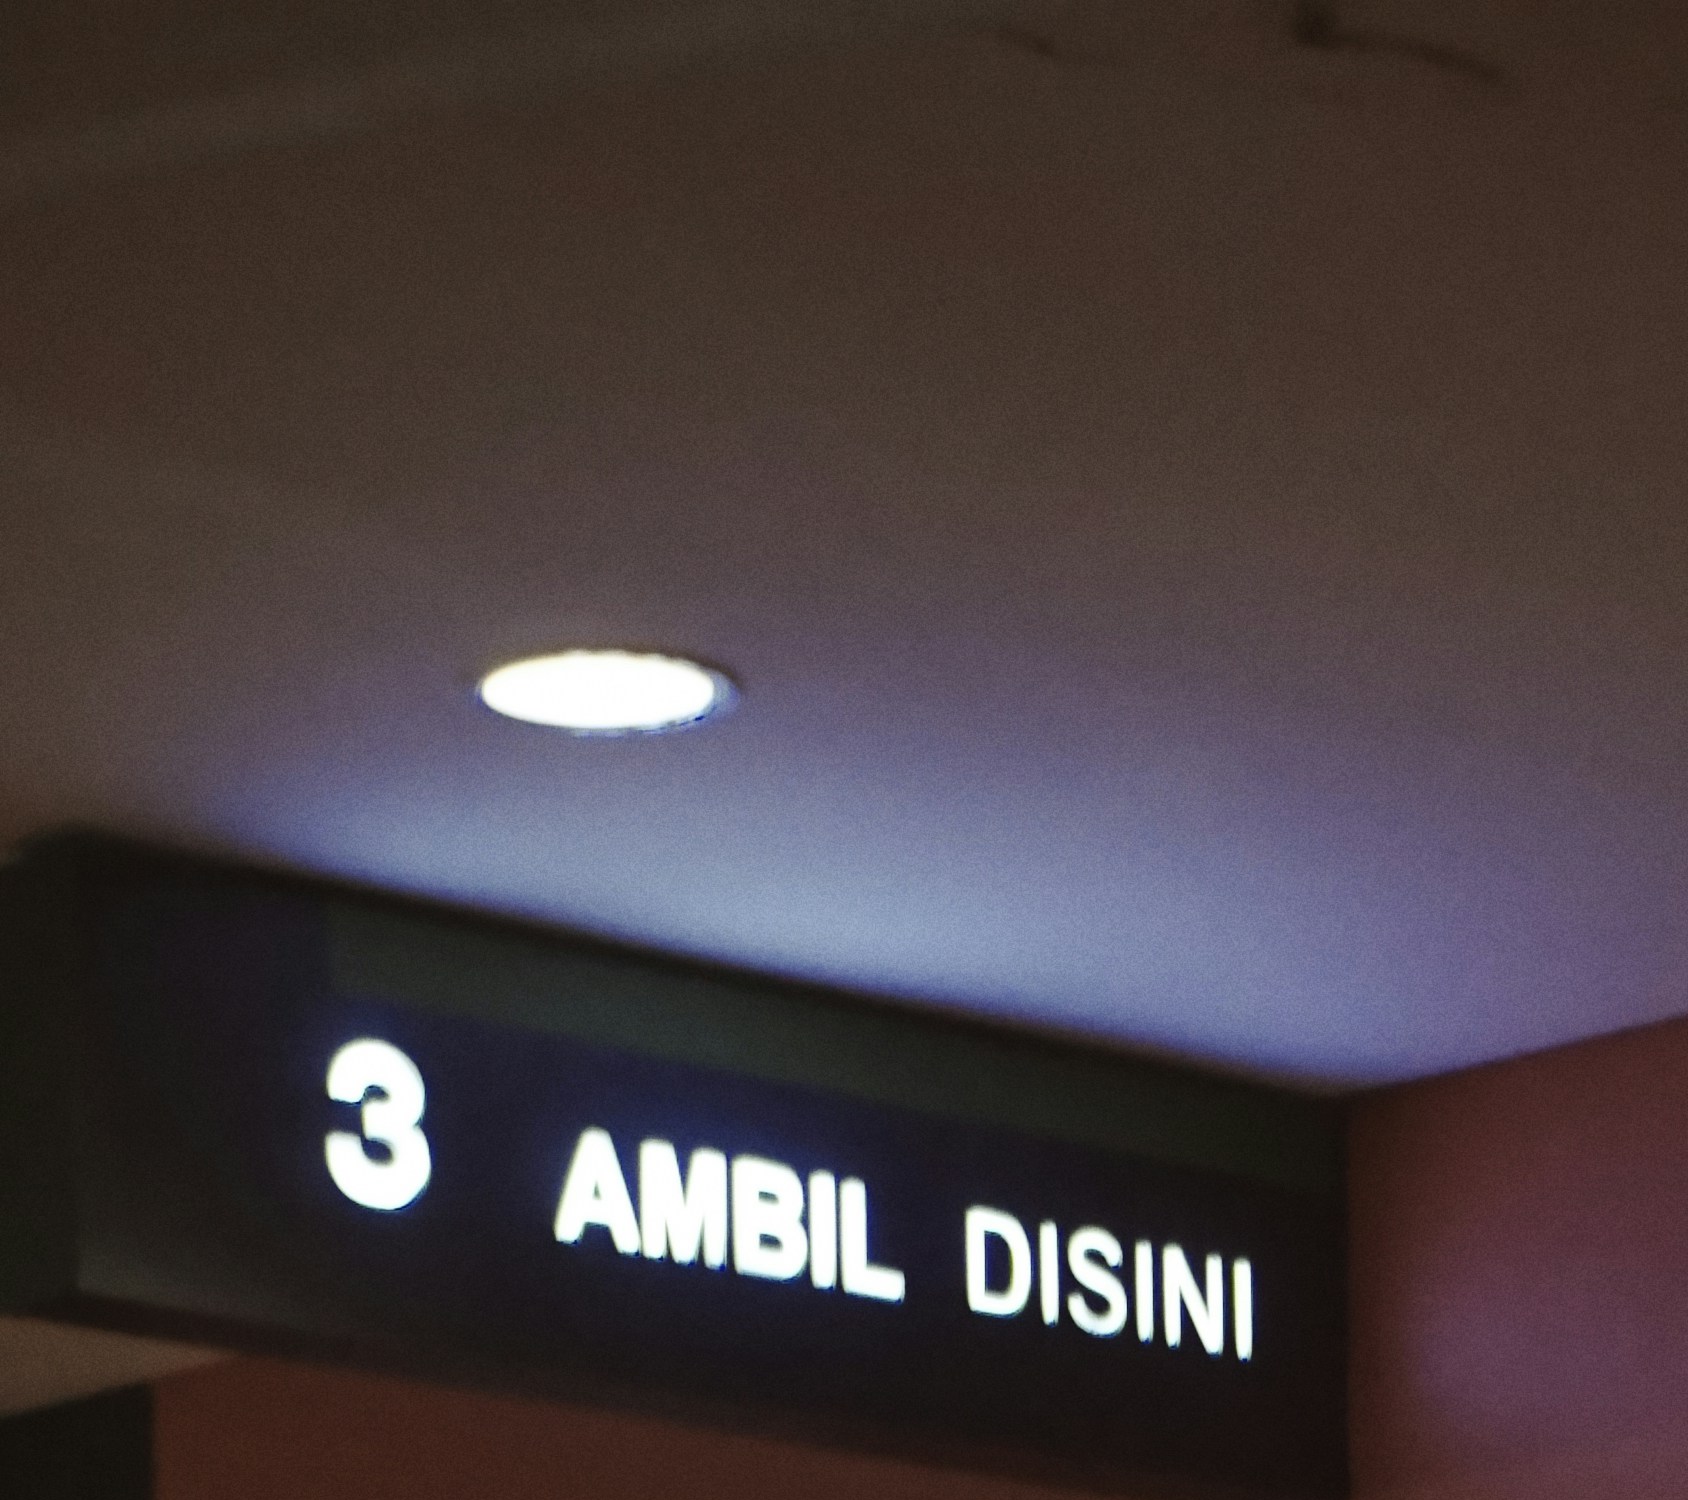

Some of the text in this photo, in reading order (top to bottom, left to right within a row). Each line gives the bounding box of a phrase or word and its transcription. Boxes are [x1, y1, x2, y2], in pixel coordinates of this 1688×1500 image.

[324, 1037, 1253, 1360] 3 AMBIL DISINI
